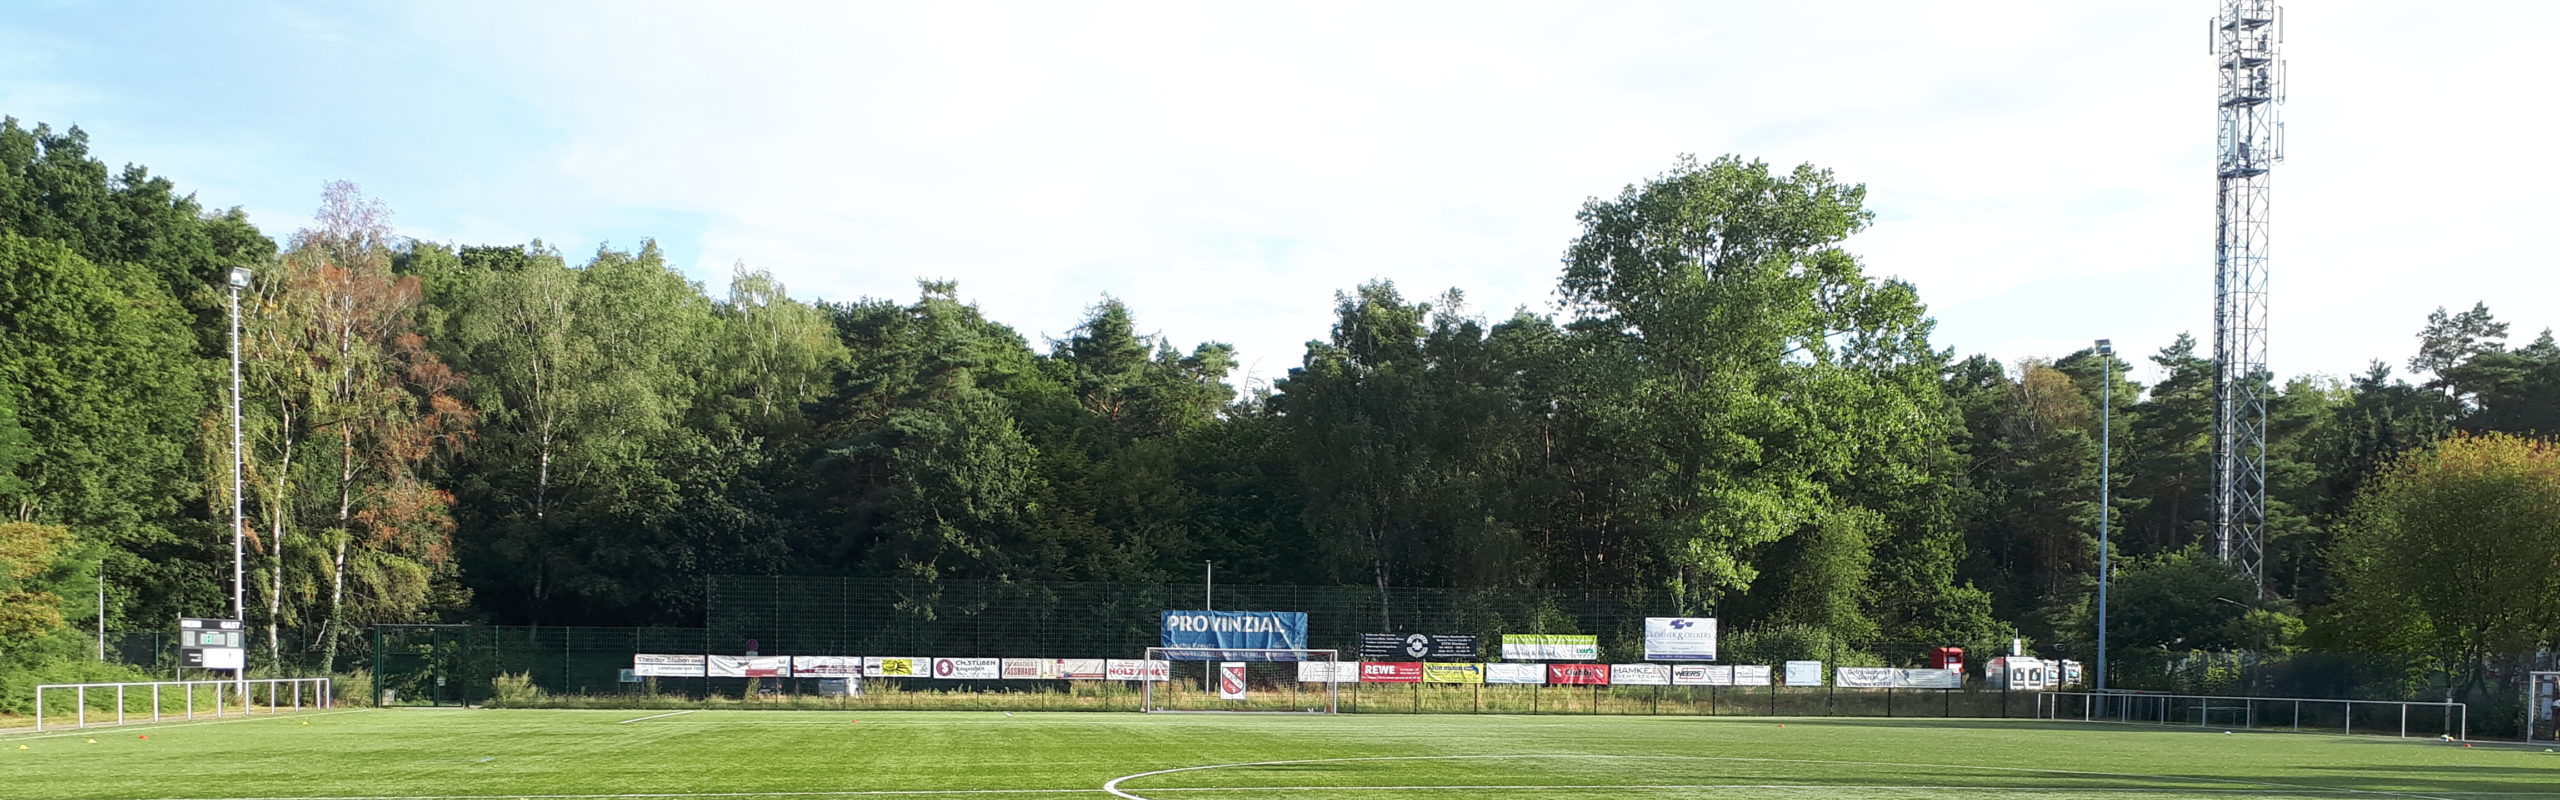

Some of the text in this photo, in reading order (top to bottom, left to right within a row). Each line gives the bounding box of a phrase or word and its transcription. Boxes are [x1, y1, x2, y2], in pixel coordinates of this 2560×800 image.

[1167, 615, 1285, 632] PROVINZIAL
[1108, 668, 1168, 676] HOLZ JNGE
[1364, 664, 1396, 675] REWE
[1565, 668, 1592, 676] Clubbi
